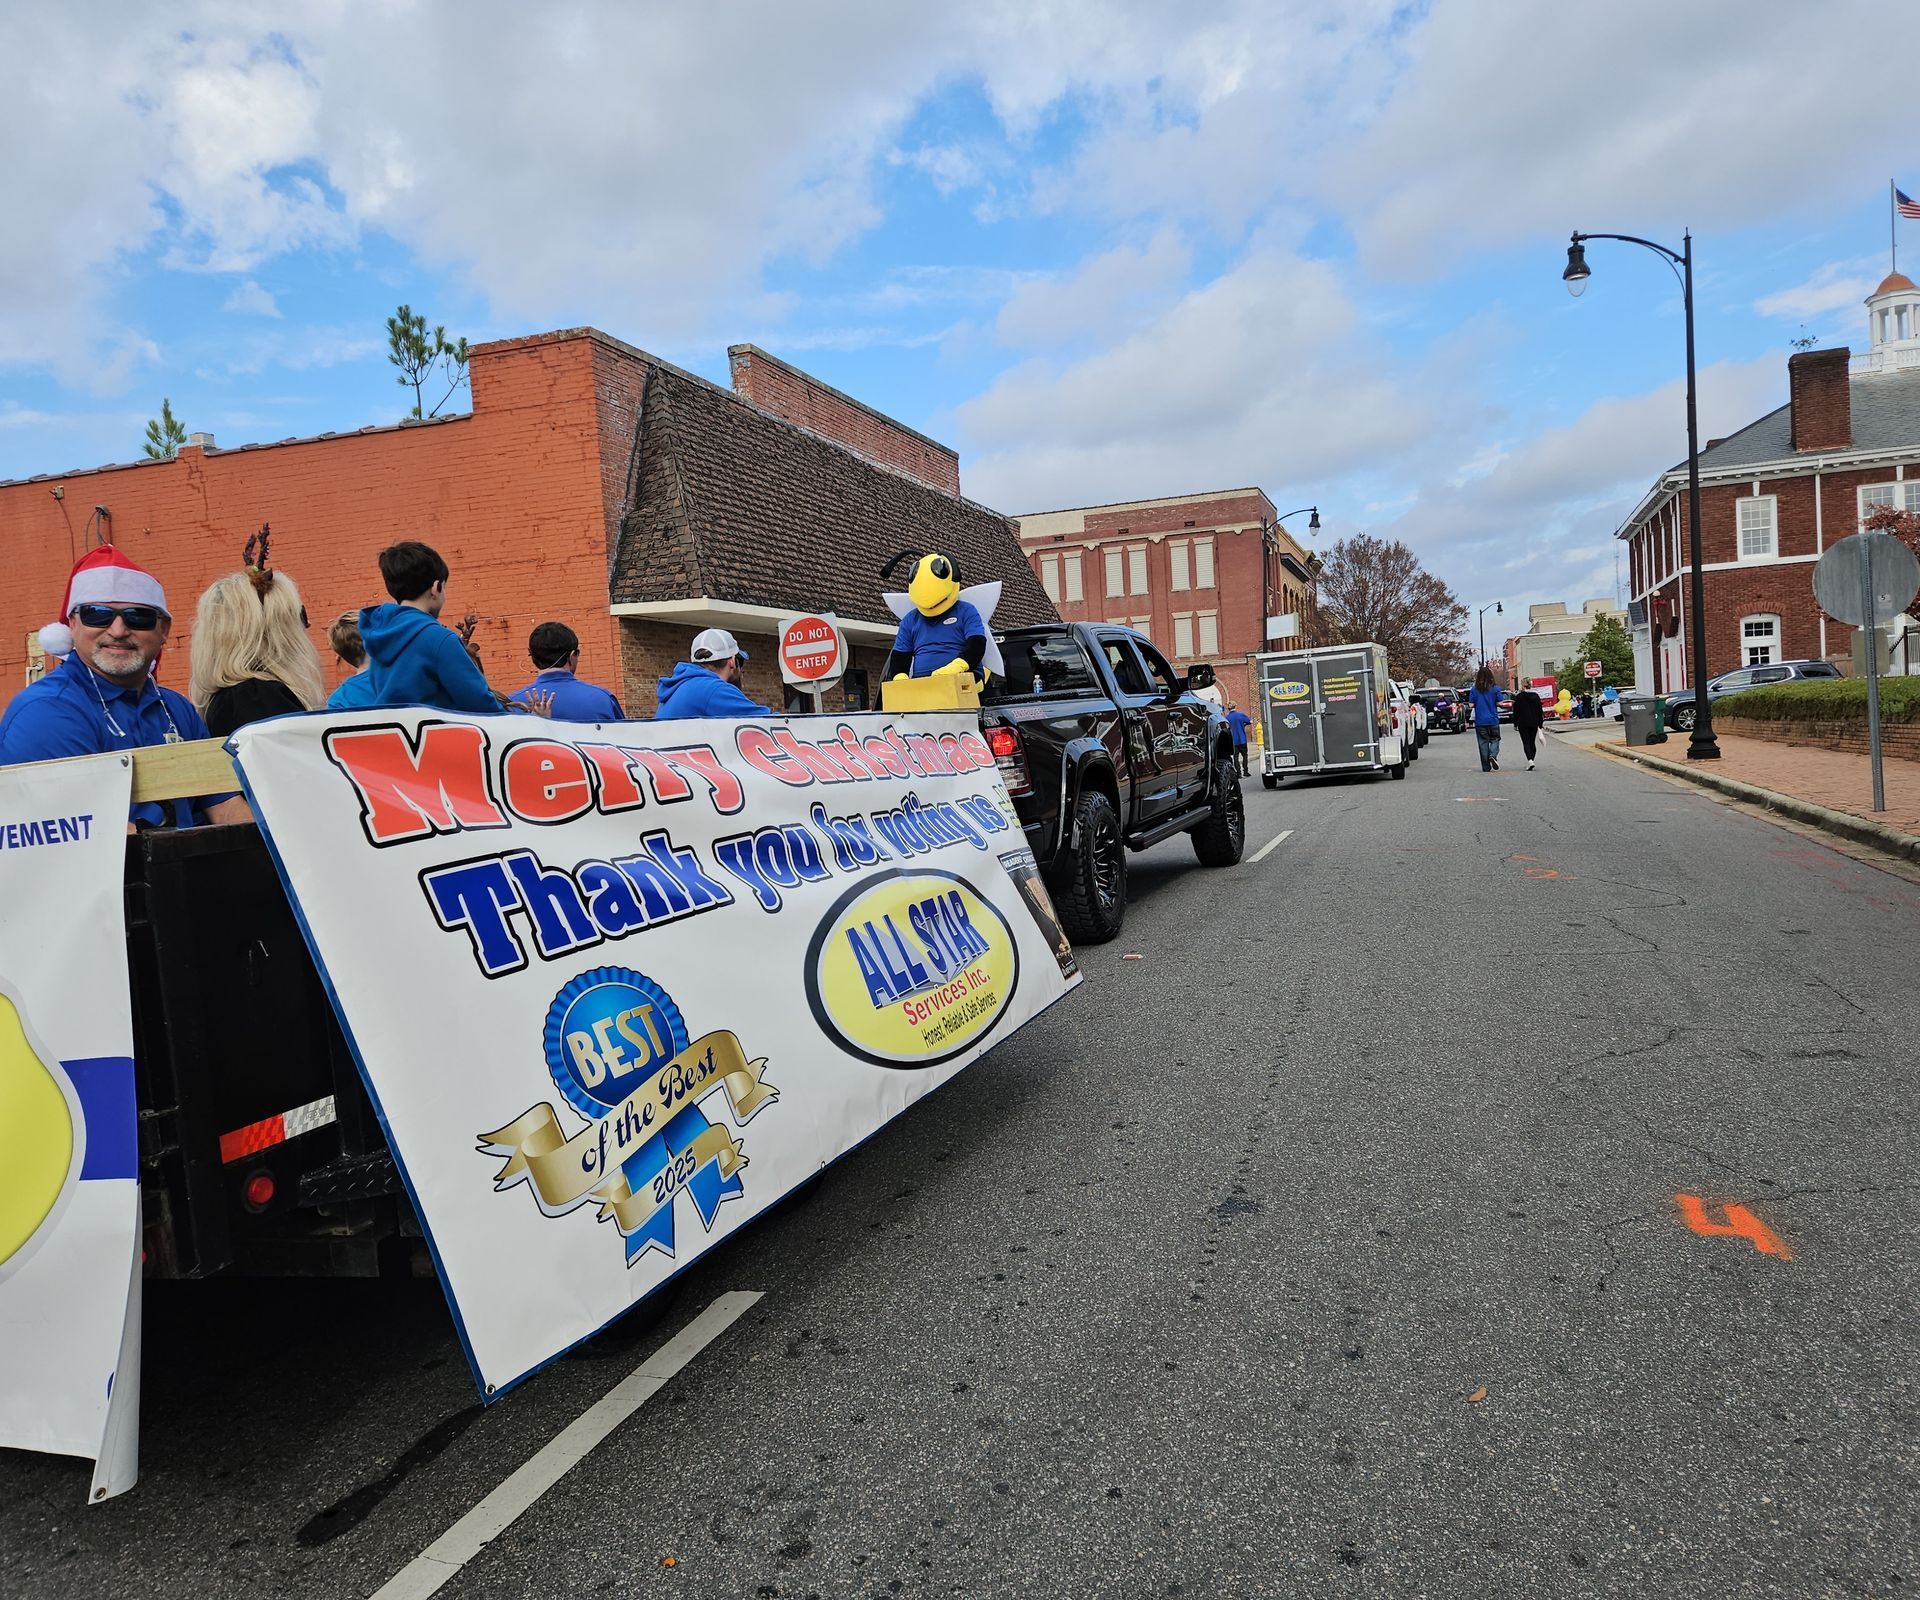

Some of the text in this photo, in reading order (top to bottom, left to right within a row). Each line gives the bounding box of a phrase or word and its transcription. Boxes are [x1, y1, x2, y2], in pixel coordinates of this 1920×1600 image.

[789, 626, 828, 642] DO NOT
[795, 655, 828, 669] ENTER
[1273, 684, 1305, 695] ALL STAR
[322, 719, 995, 849] Merry Christmas
[418, 829, 735, 980] Thank
[712, 823, 833, 913] you
[810, 802, 892, 872] for
[870, 791, 989, 851] voting
[956, 795, 1009, 834] us
[845, 890, 990, 1010] ALL STAR
[903, 967, 991, 1026] Services Inc.
[921, 991, 998, 1049] Honest, Reliable & Safe Services
[566, 1003, 666, 1089] BEST
[581, 1046, 719, 1178] of the Best
[653, 1147, 697, 1205] 2025
